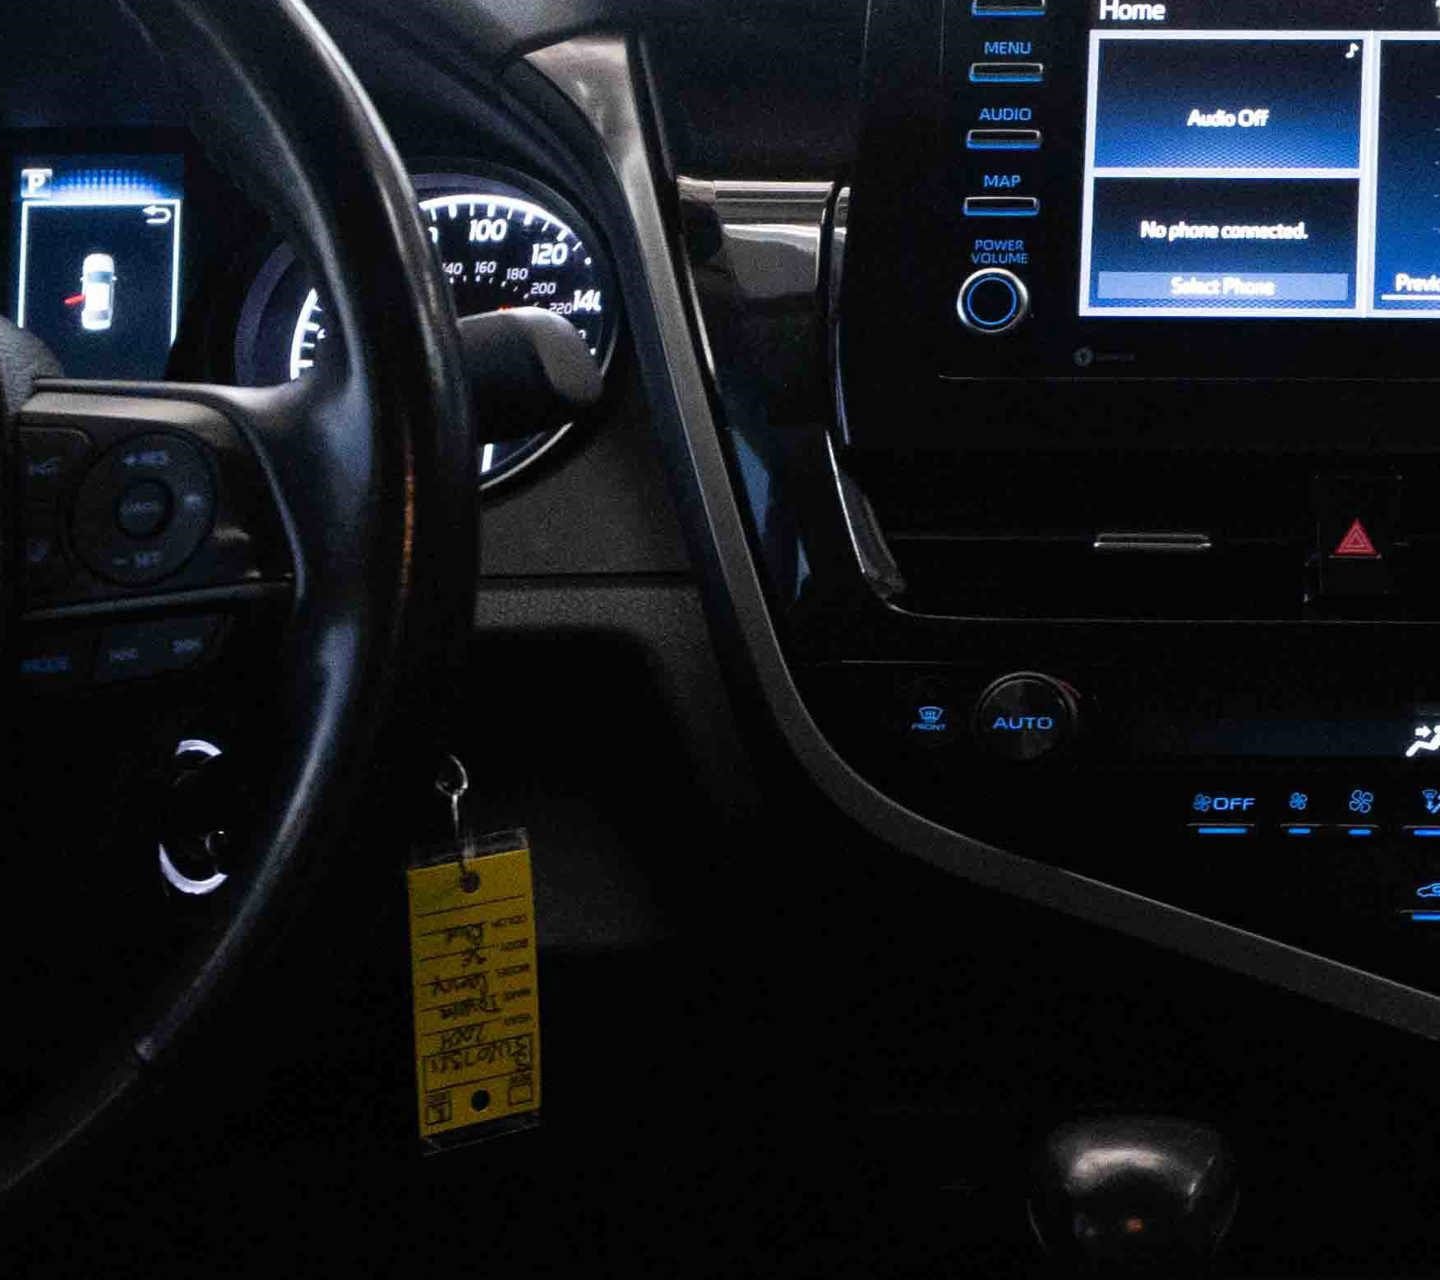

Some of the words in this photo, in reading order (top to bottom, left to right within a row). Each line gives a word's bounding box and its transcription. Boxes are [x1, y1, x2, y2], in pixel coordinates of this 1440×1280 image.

[983, 41, 1032, 55] MENU
[979, 107, 1032, 121] AUDIO
[1186, 108, 1236, 127] Audio
[1237, 108, 1270, 127] Off
[983, 175, 1022, 188] MAP
[468, 218, 508, 242] 100
[1139, 220, 1167, 239] No
[1167, 221, 1219, 242] phone
[1220, 221, 1309, 240] connected.
[974, 239, 1025, 251] POWER
[530, 242, 568, 266] 120
[970, 252, 1030, 265] VOLUME
[474, 261, 497, 274] 160
[506, 267, 529, 281] 180
[530, 282, 557, 295] 200
[1170, 276, 1221, 296] Select
[1223, 277, 1276, 297] Phone
[991, 716, 1055, 730] AUTO
[1212, 797, 1257, 811] OFF
